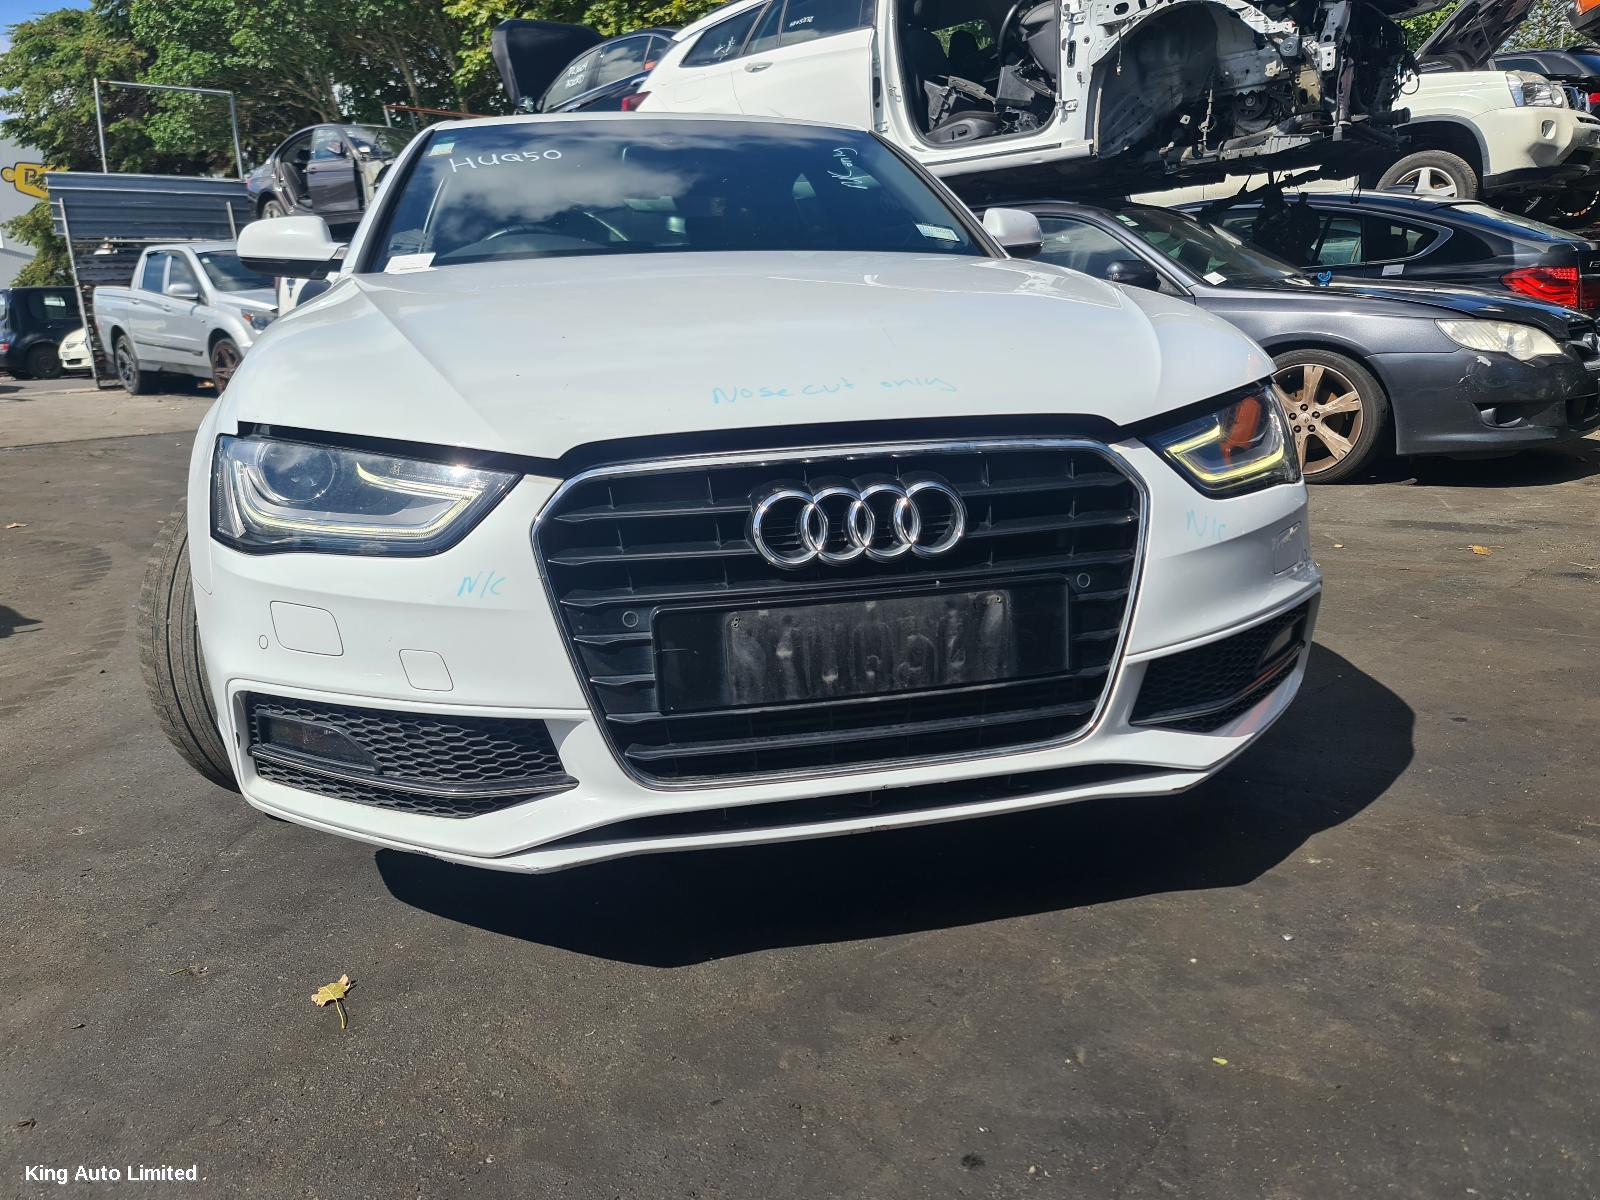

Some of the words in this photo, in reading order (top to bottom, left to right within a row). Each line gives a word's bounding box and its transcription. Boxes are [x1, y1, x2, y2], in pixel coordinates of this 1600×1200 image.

[449, 149, 562, 173] HUQ50
[711, 386, 793, 405] Nose
[801, 377, 855, 395] cut
